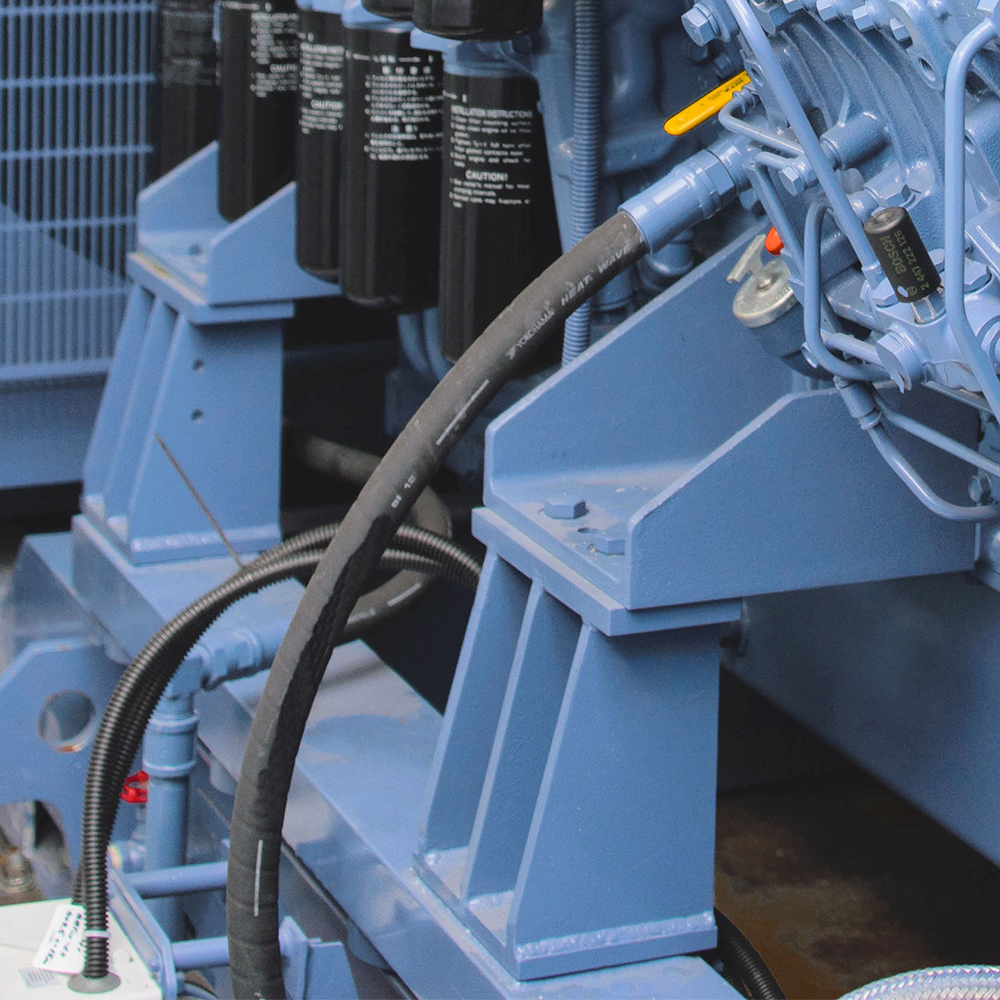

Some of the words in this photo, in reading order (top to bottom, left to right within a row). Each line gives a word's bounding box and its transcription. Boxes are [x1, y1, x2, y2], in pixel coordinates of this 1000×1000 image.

[465, 170, 508, 182] CAUTION!
[879, 235, 907, 274] BOSCH
[902, 246, 917, 265] 222
[516, 309, 555, 349] YOKOHAMA
[560, 274, 592, 306] HEAT
[597, 242, 632, 274] WAVE
